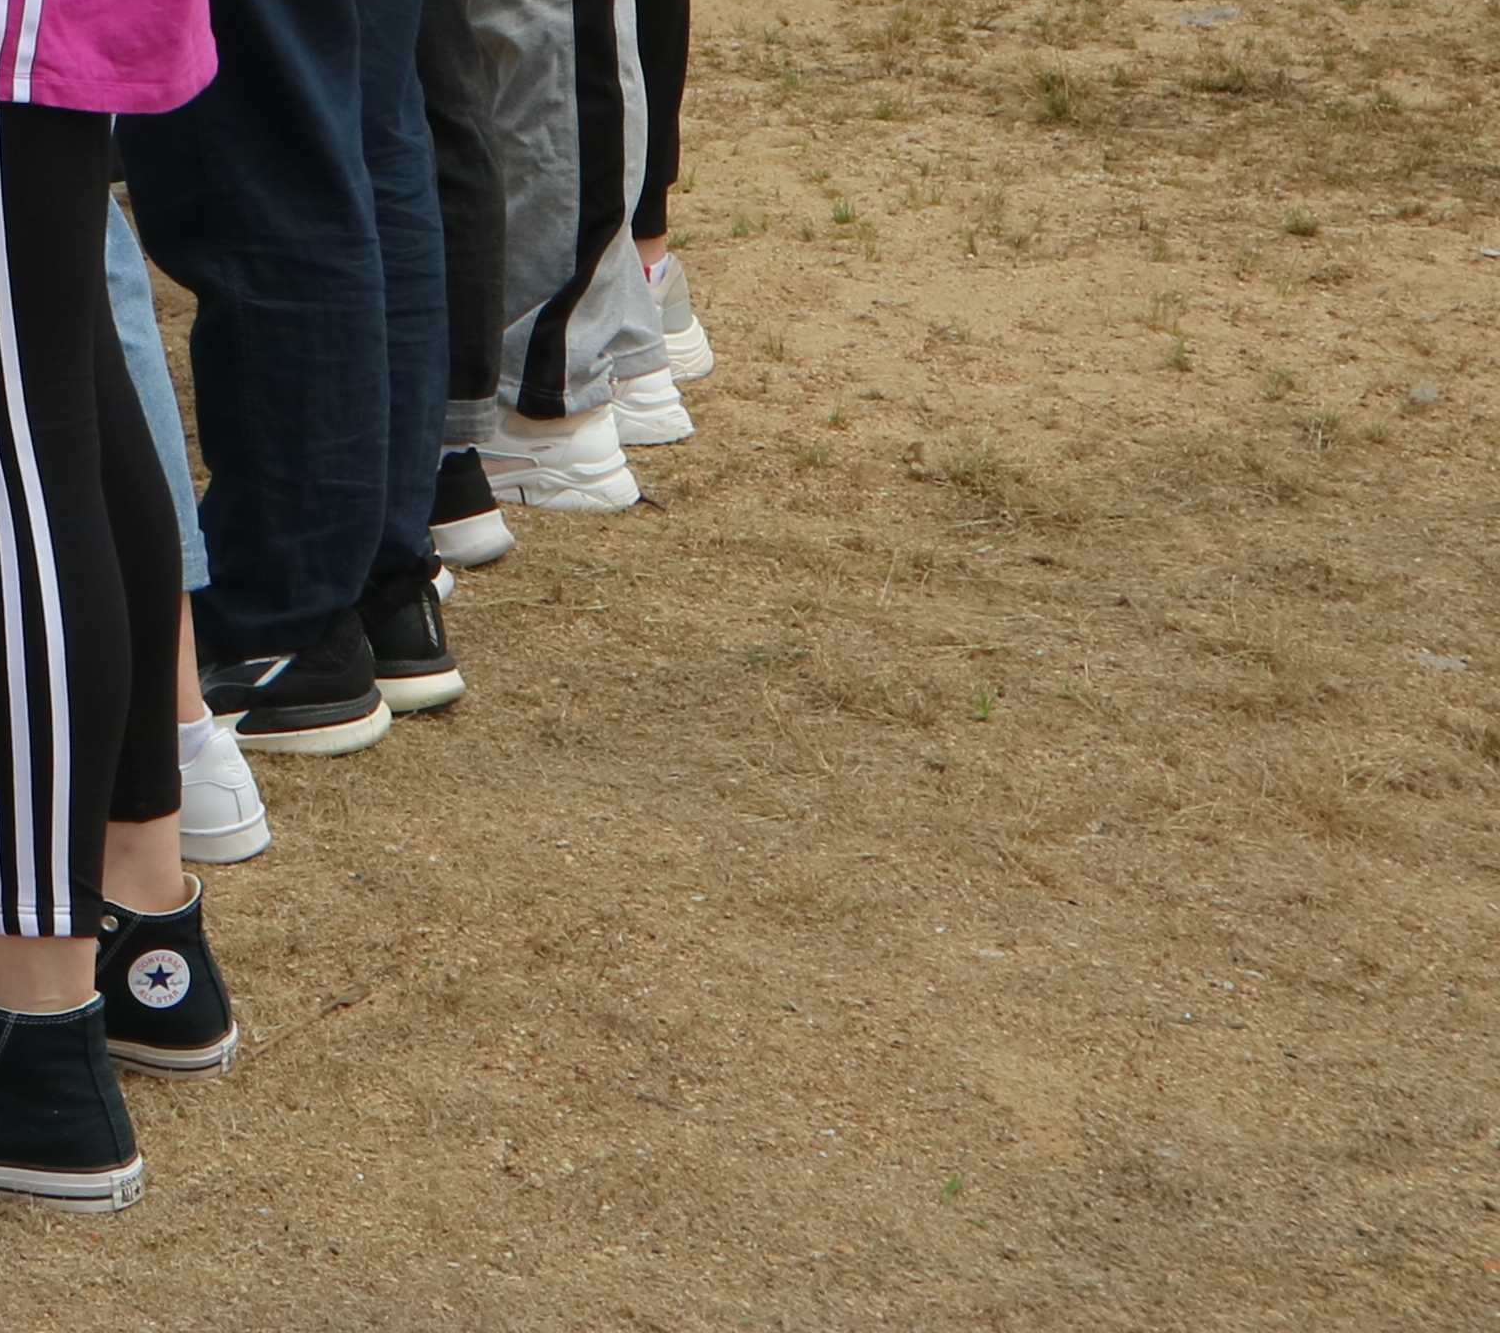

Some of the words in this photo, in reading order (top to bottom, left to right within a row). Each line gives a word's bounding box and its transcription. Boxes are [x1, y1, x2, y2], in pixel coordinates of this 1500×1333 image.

[136, 955, 182, 972] CONVERSE
[139, 989, 153, 1002] ALL
[156, 989, 180, 1003] STAR
